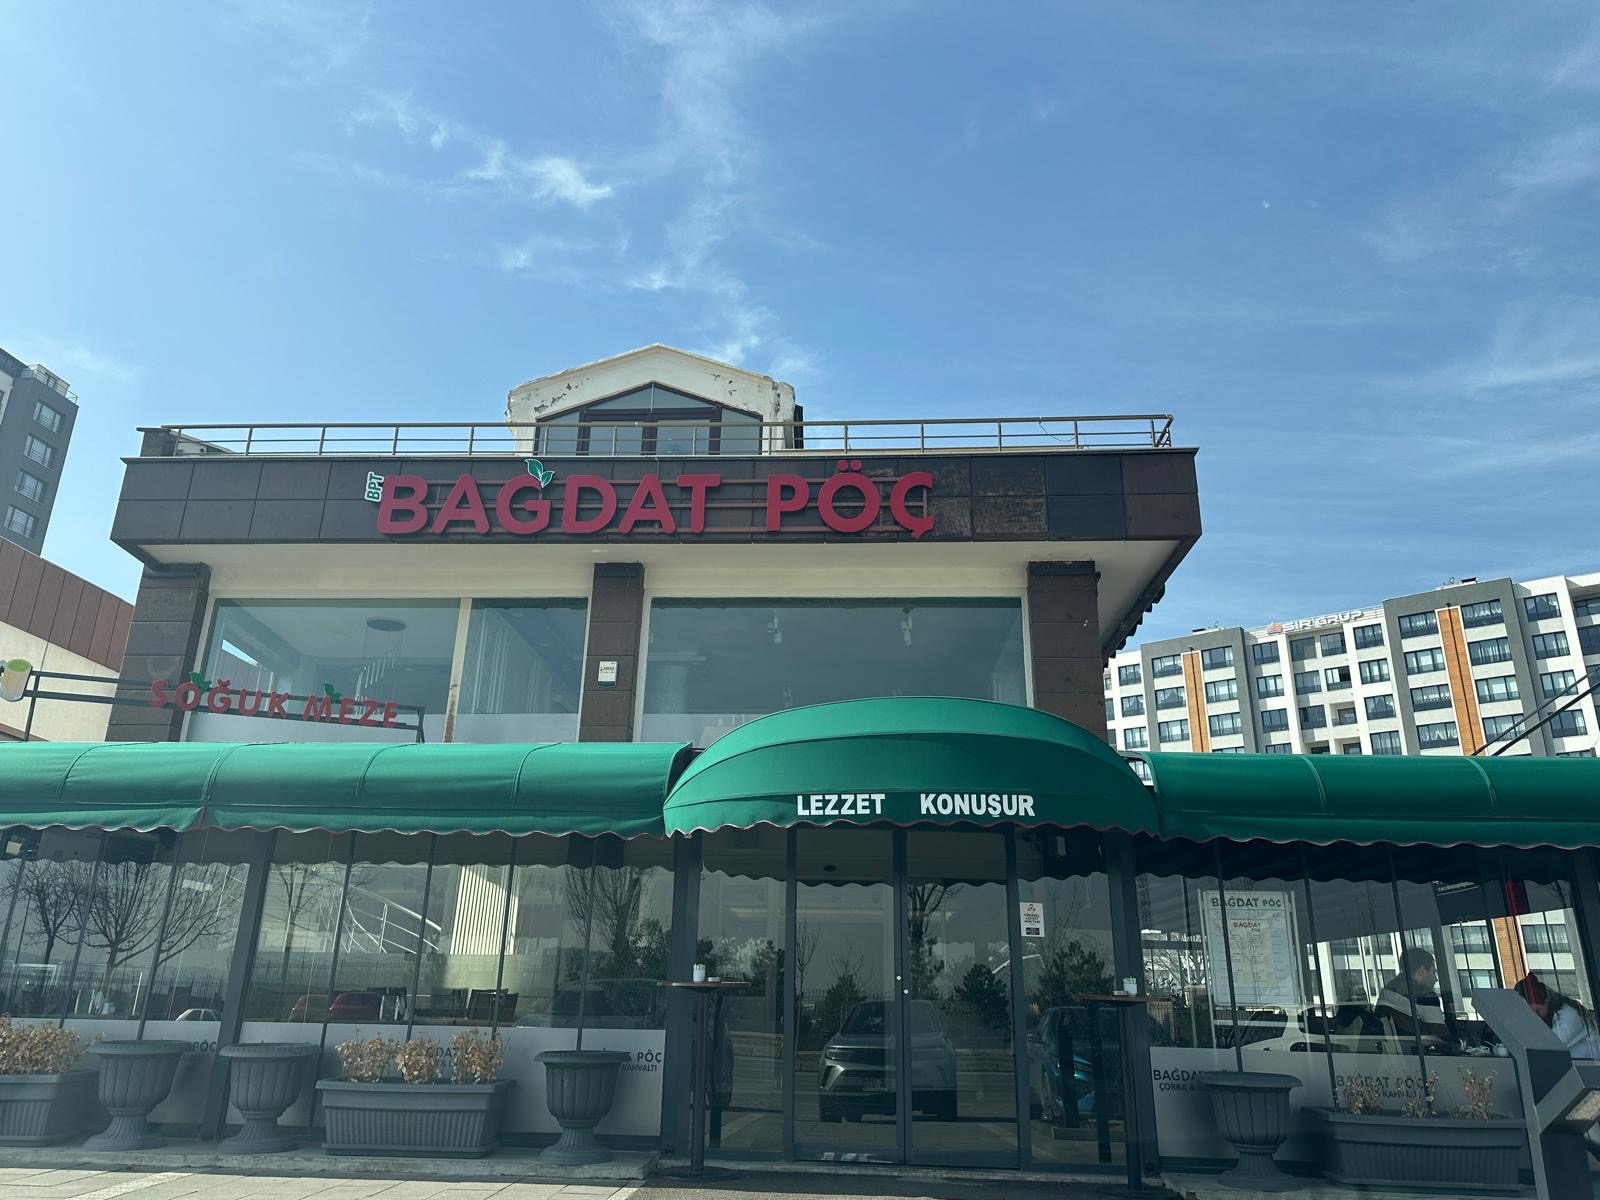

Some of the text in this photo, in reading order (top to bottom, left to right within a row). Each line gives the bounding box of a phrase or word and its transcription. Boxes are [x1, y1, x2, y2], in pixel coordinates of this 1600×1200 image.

[365, 471, 384, 502] BPT
[766, 459, 934, 539] PÖÇ
[150, 679, 401, 728] SOĞUK MEZE
[797, 793, 1036, 818] LEZZET KONUŞUR
[637, 1049, 662, 1064] PÖÇ
[1153, 1067, 1199, 1081] BAĞDA
